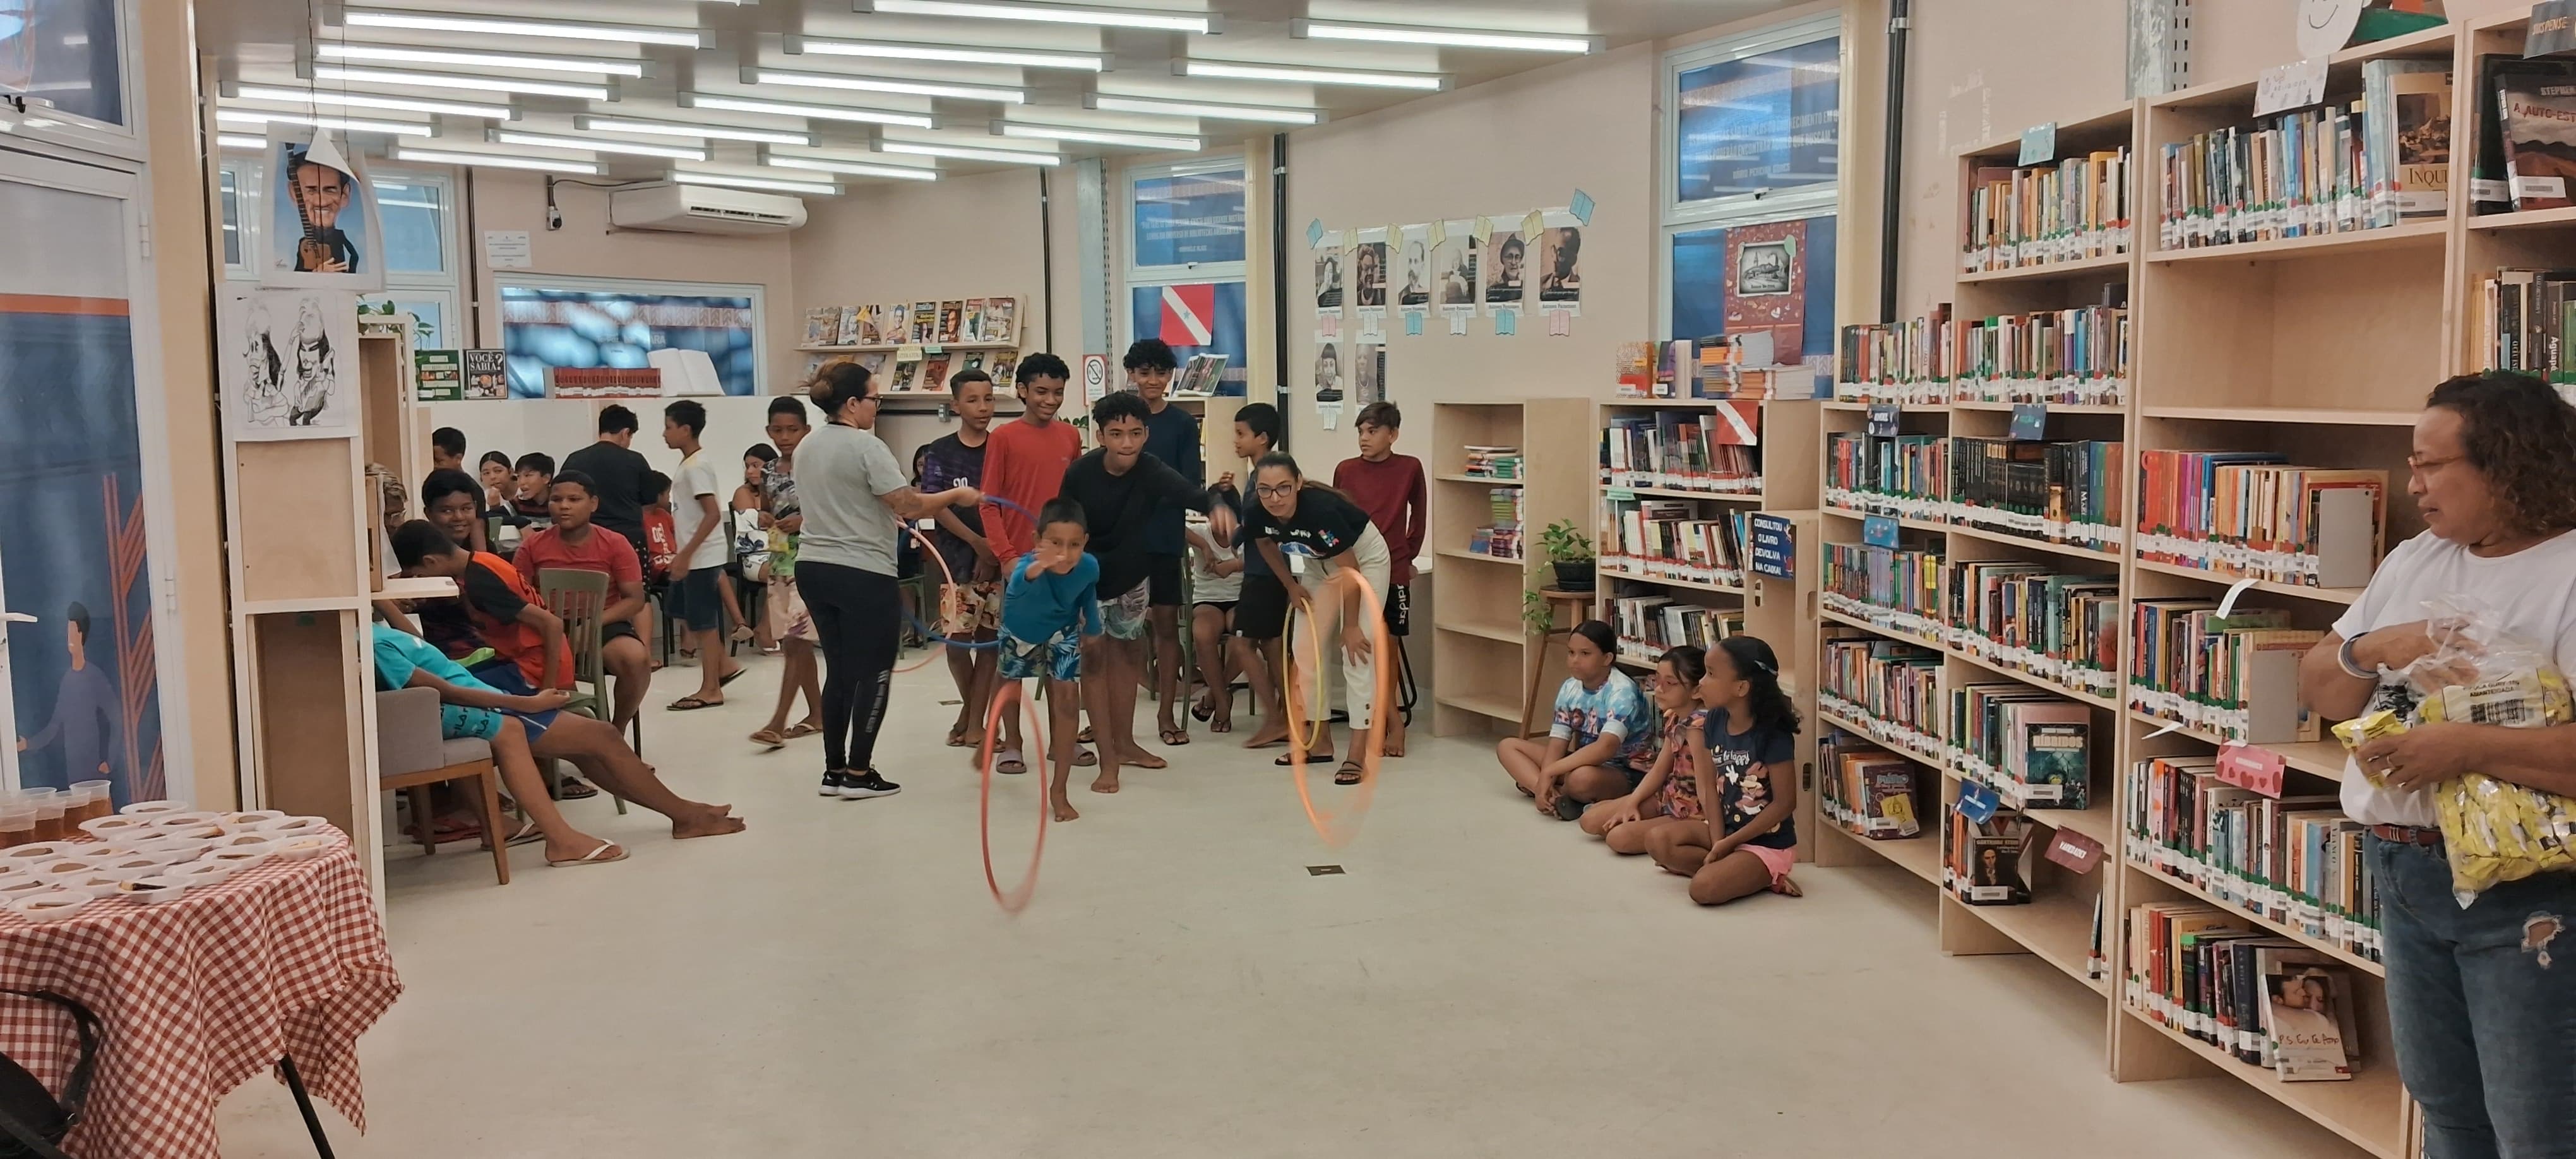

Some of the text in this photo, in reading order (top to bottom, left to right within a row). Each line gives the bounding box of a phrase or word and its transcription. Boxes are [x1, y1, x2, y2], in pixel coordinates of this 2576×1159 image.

[1754, 518, 1782, 532] CONSULTOU
[1762, 534, 1778, 545] LIVRO
[1755, 547, 1780, 561] DEVOLVA
